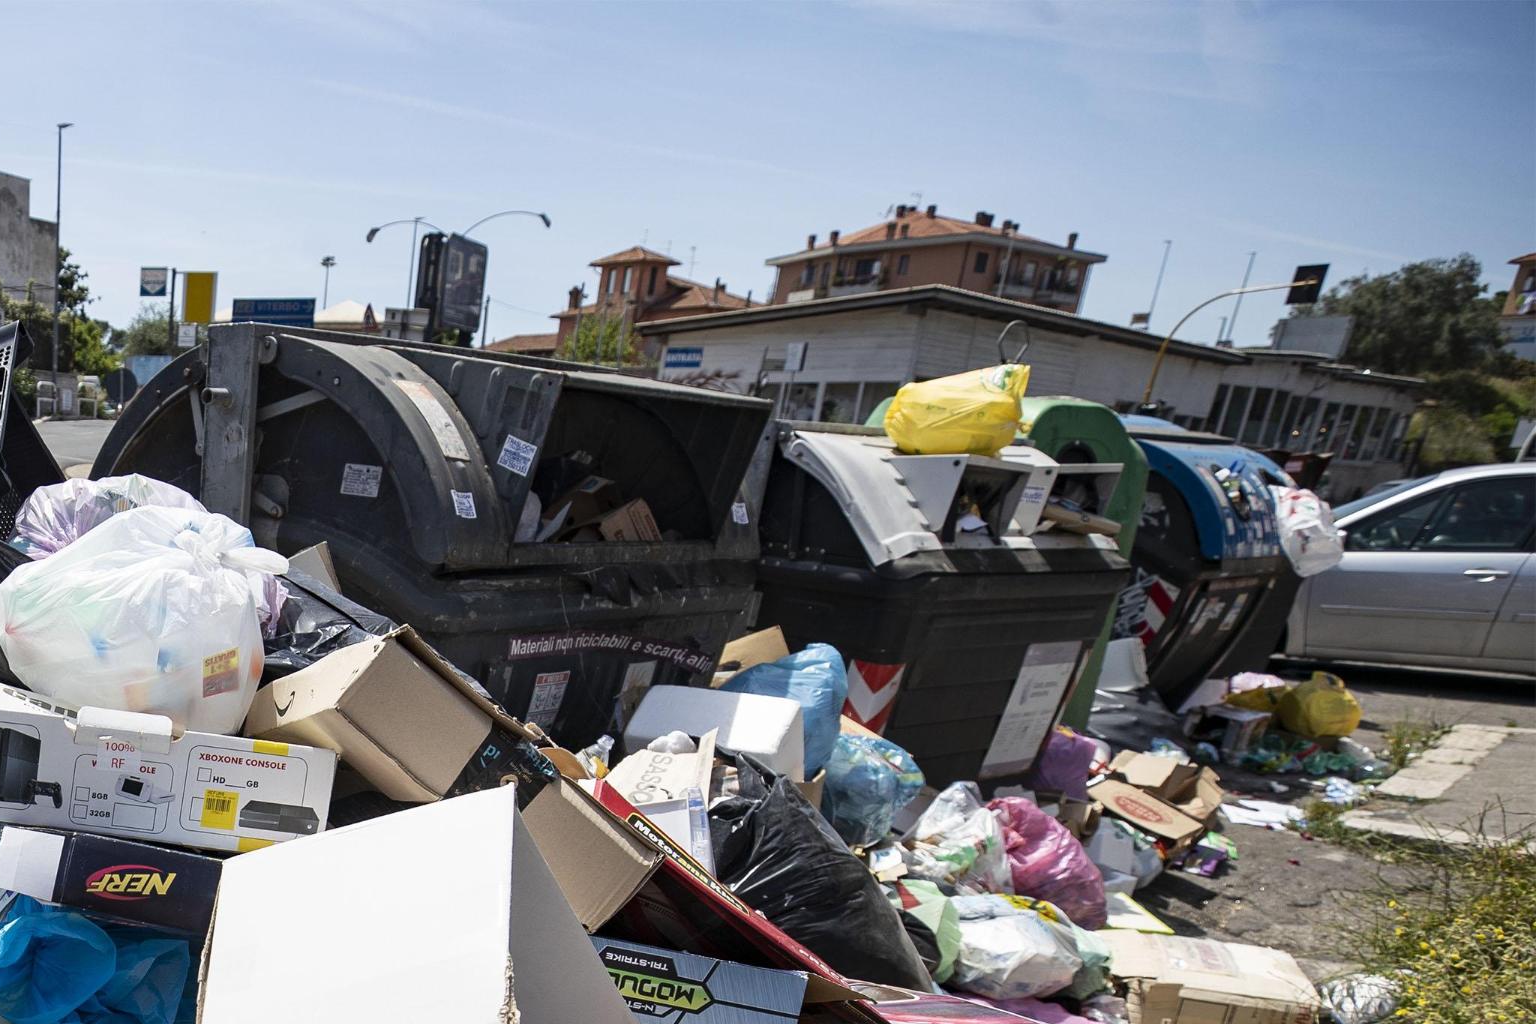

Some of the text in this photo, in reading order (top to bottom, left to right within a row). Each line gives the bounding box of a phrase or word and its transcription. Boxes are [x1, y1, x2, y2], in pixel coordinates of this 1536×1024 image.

[511, 636, 555, 656] Materiali
[575, 633, 632, 650] riciclabili
[632, 641, 641, 651] e
[105, 741, 136, 753] 100%
[111, 758, 125, 769] RF
[199, 752, 286, 771] XBOXONE CONSOLE
[91, 792, 108, 801] 8GB
[89, 810, 111, 818] 32GB
[634, 820, 709, 889] Motorama
[86, 873, 177, 896] NERF
[605, 952, 668, 972] TRI-STRIKE
